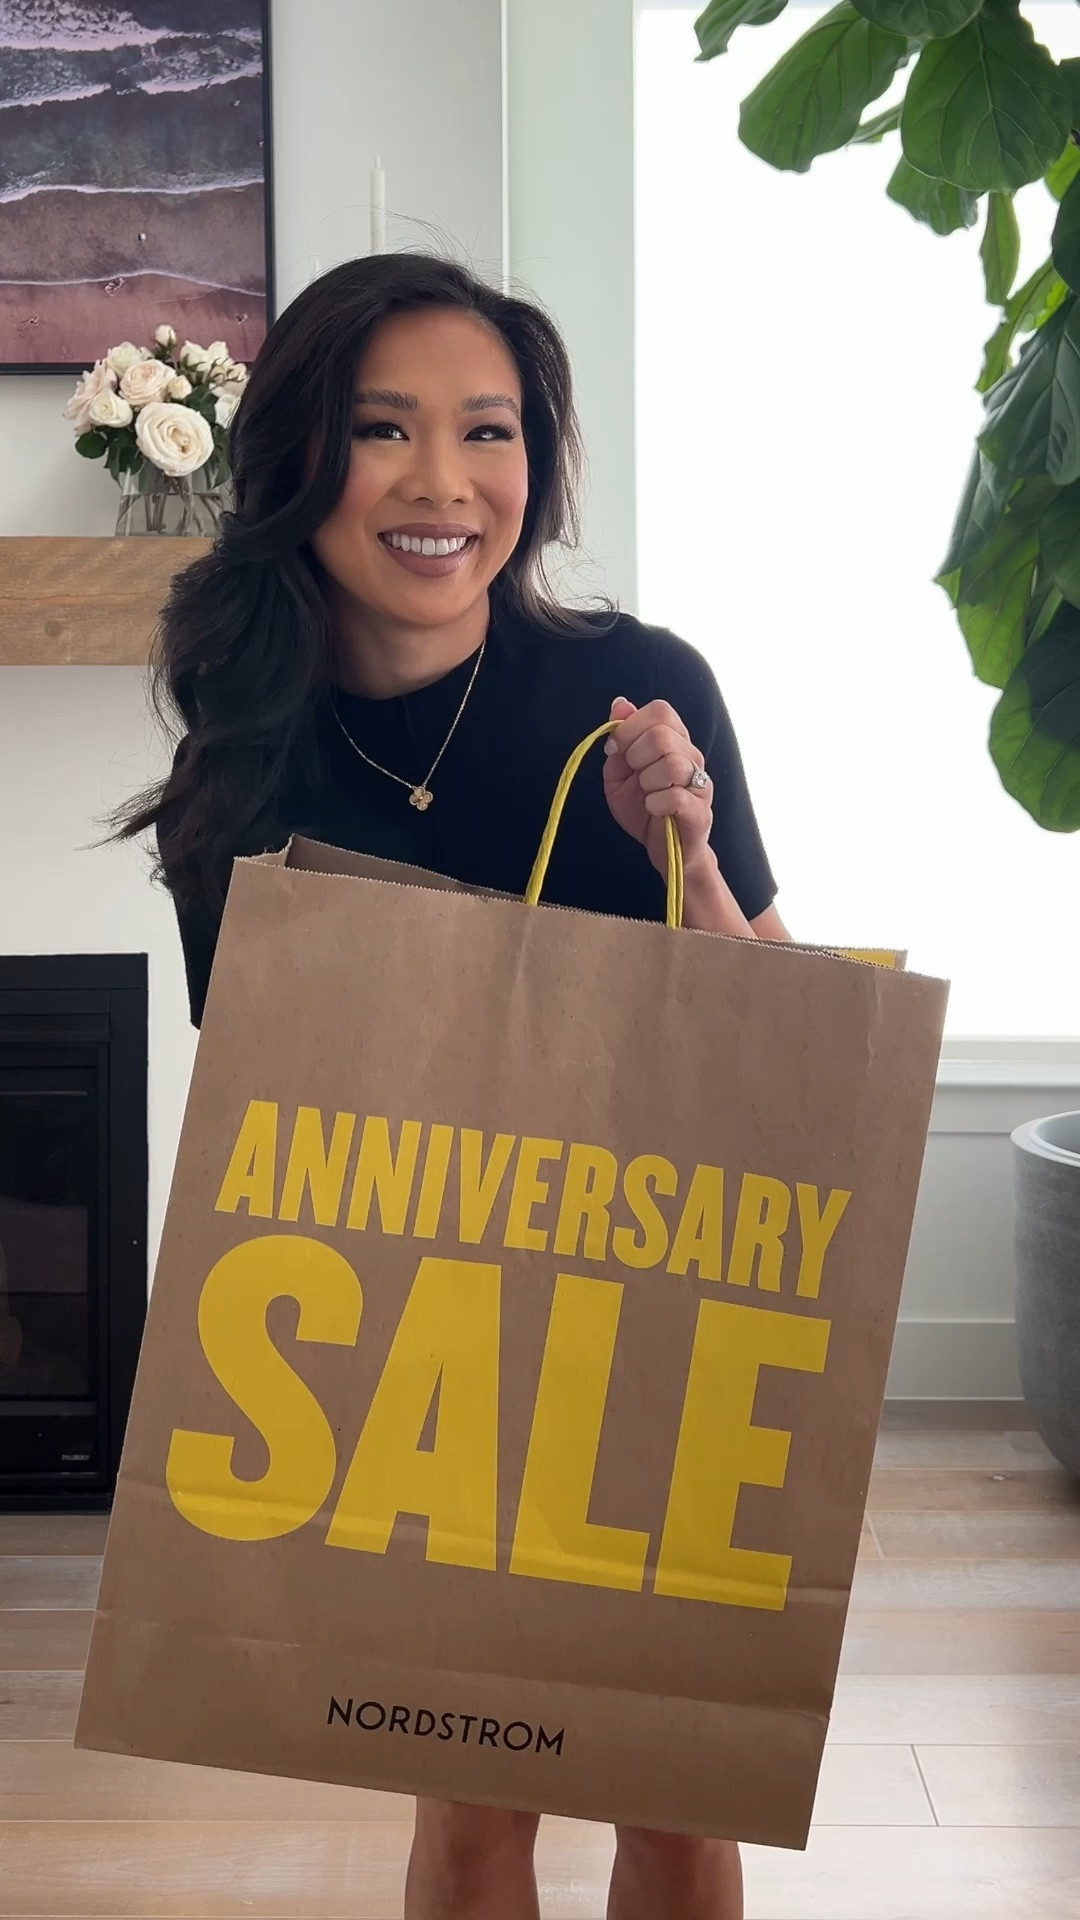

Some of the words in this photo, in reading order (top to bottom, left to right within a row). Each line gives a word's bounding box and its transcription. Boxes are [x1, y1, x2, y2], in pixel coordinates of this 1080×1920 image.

[215, 1100, 850, 1299] ANNIVERSARY
[166, 1235, 831, 1611] SALE
[327, 1695, 565, 1756] NORDSTROM
